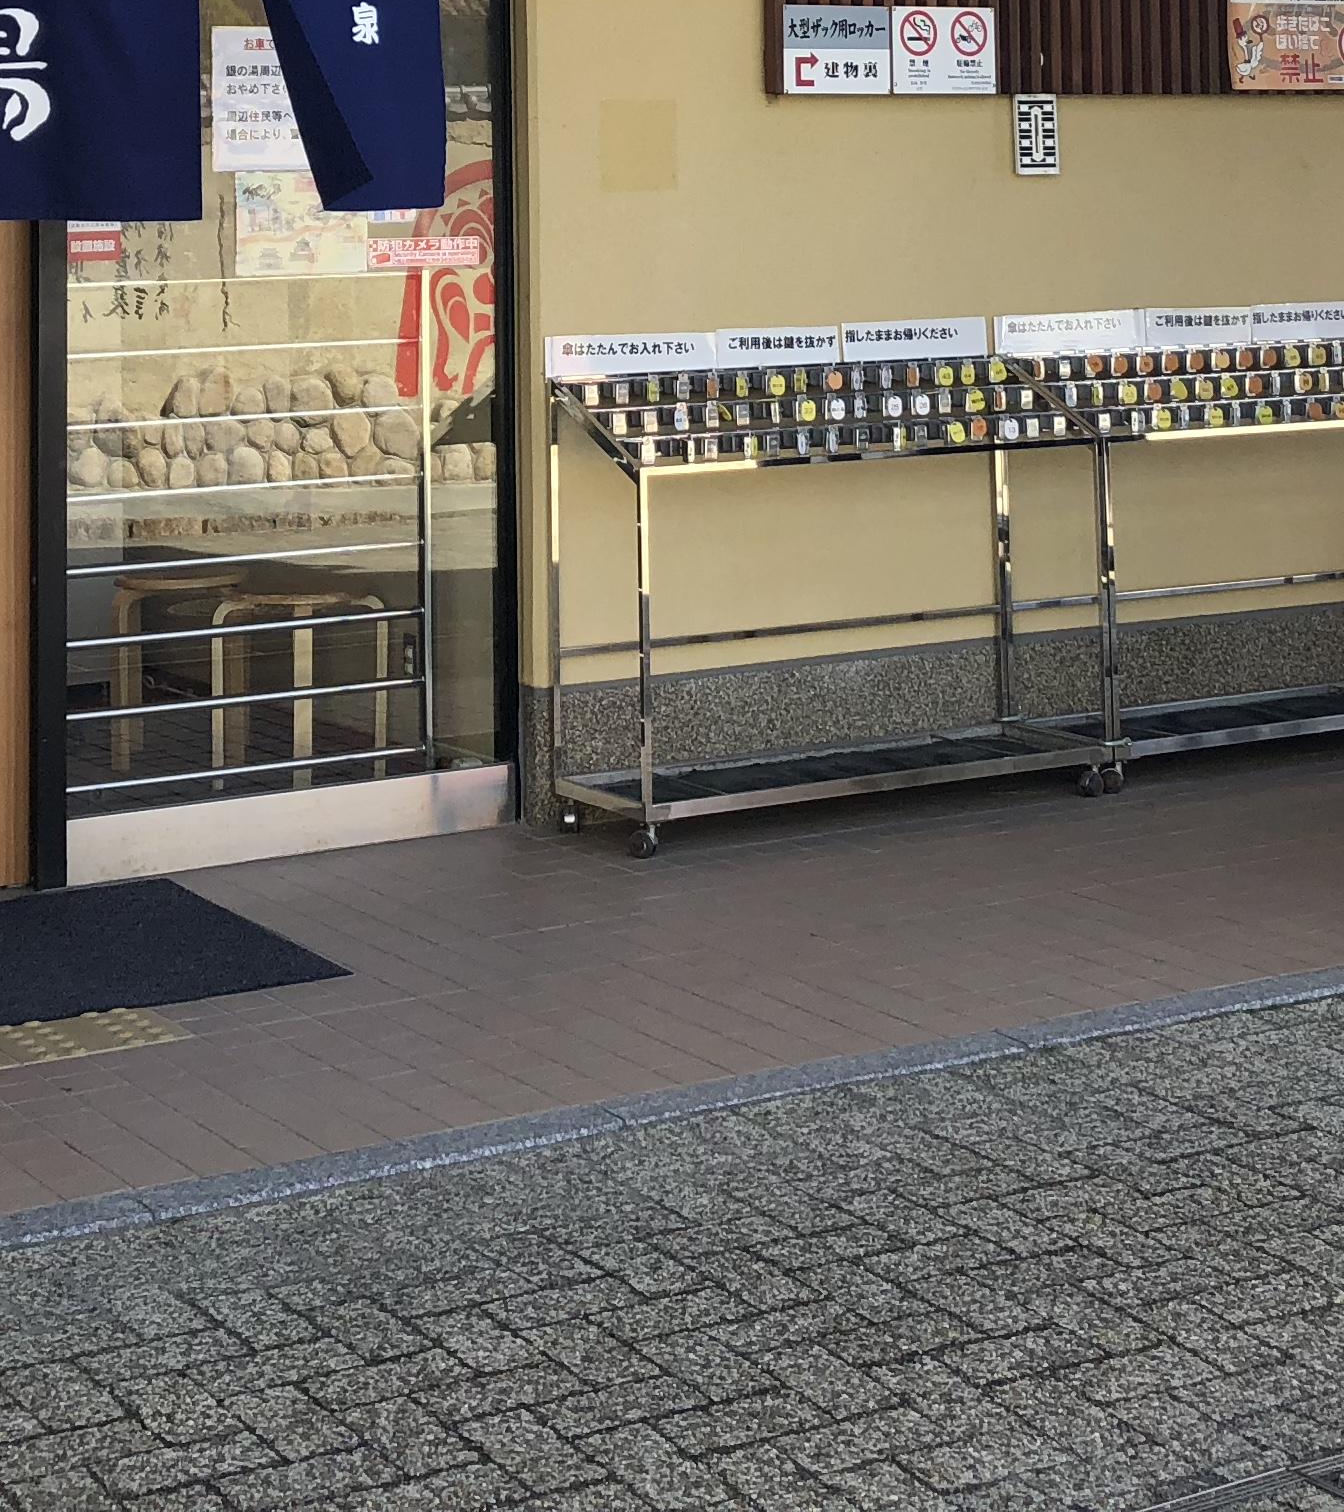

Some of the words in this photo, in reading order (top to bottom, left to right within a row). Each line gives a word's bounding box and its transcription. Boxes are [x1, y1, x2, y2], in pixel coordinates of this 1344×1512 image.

[788, 17, 885, 39] 大型ザック用ロッカー
[824, 62, 878, 78] 建物裏
[1280, 53, 1324, 84] 禁止
[377, 238, 478, 251] 防犯カメラ動作中
[1008, 318, 1121, 334] 傘はたたんでお入れ下さい
[562, 342, 694, 356] 傘はたたんでお入れ下さい
[727, 334, 836, 350] ご利用後は鍵を抜かず
